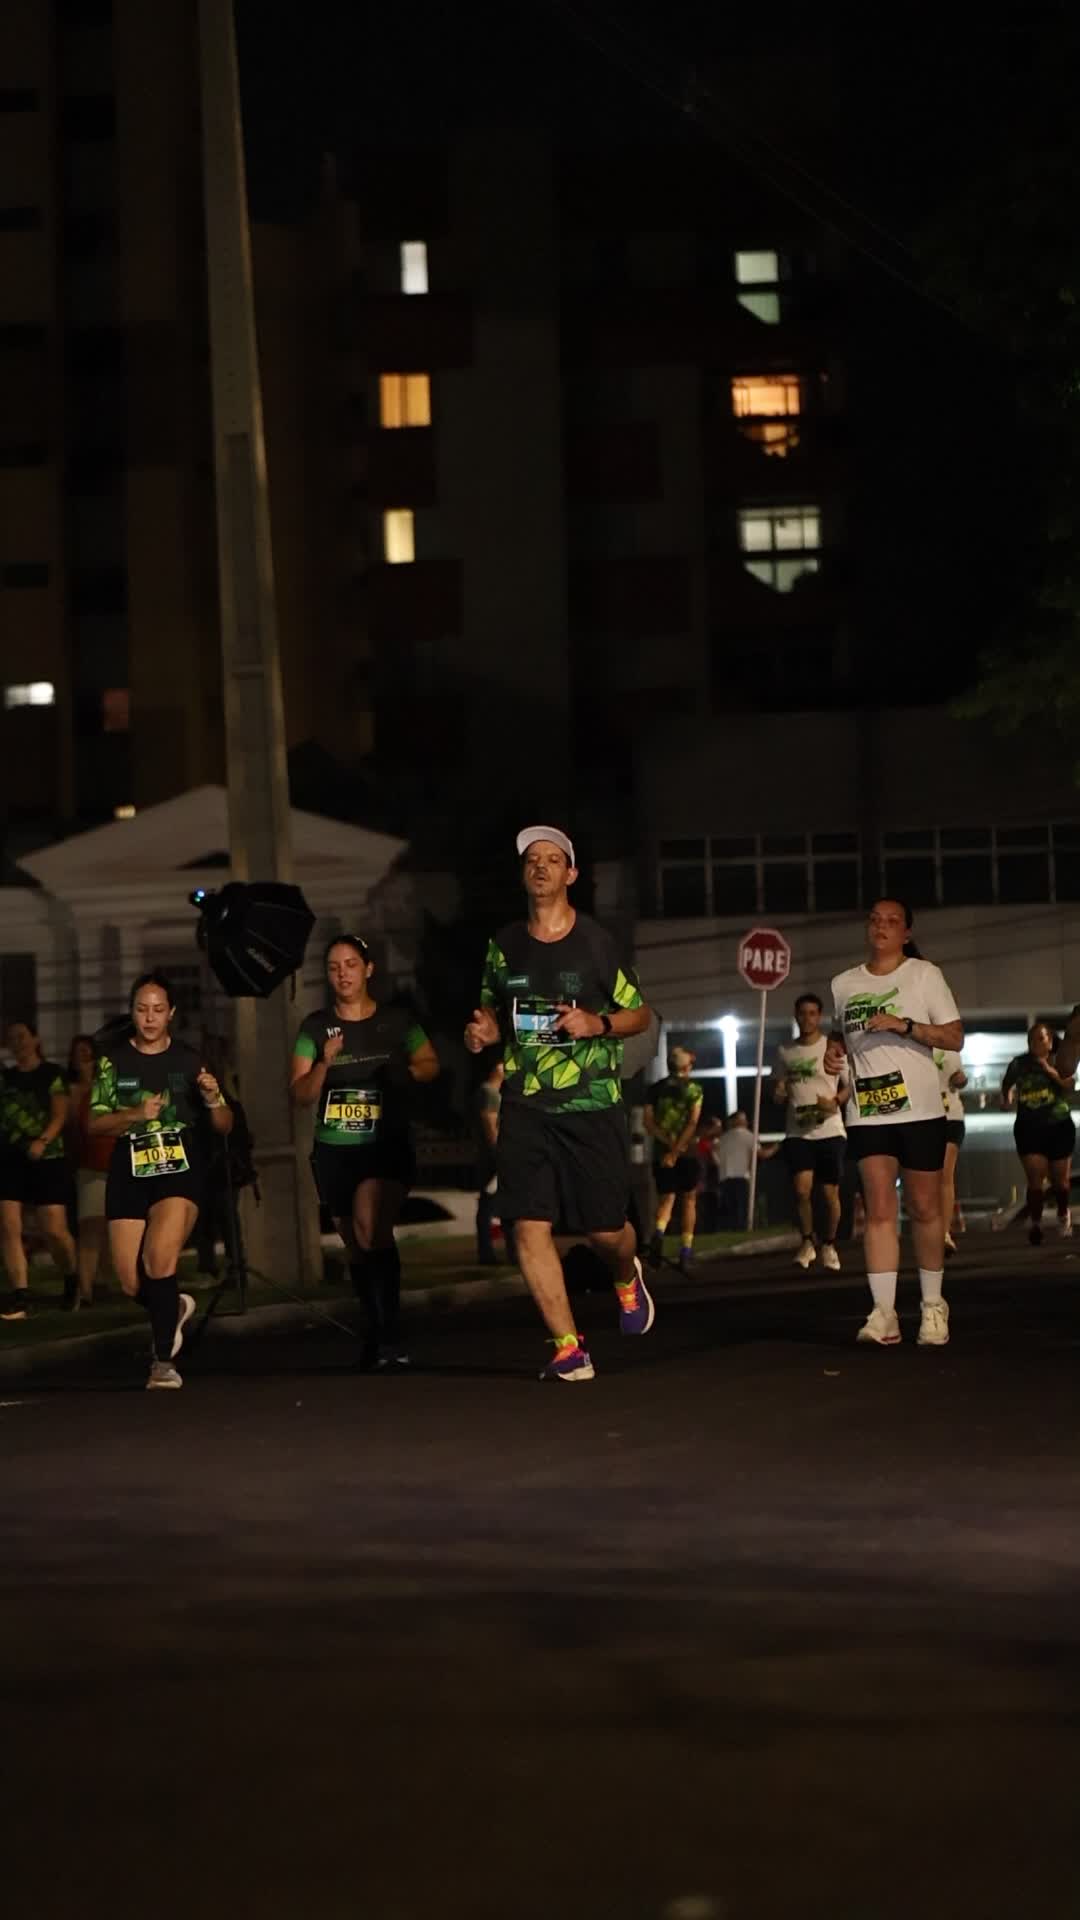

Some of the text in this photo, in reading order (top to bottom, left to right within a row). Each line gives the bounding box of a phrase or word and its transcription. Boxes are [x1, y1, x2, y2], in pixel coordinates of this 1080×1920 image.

[743, 947, 785, 973] PARE
[864, 1087, 899, 1104] 2656
[337, 1105, 372, 1119] 1063
